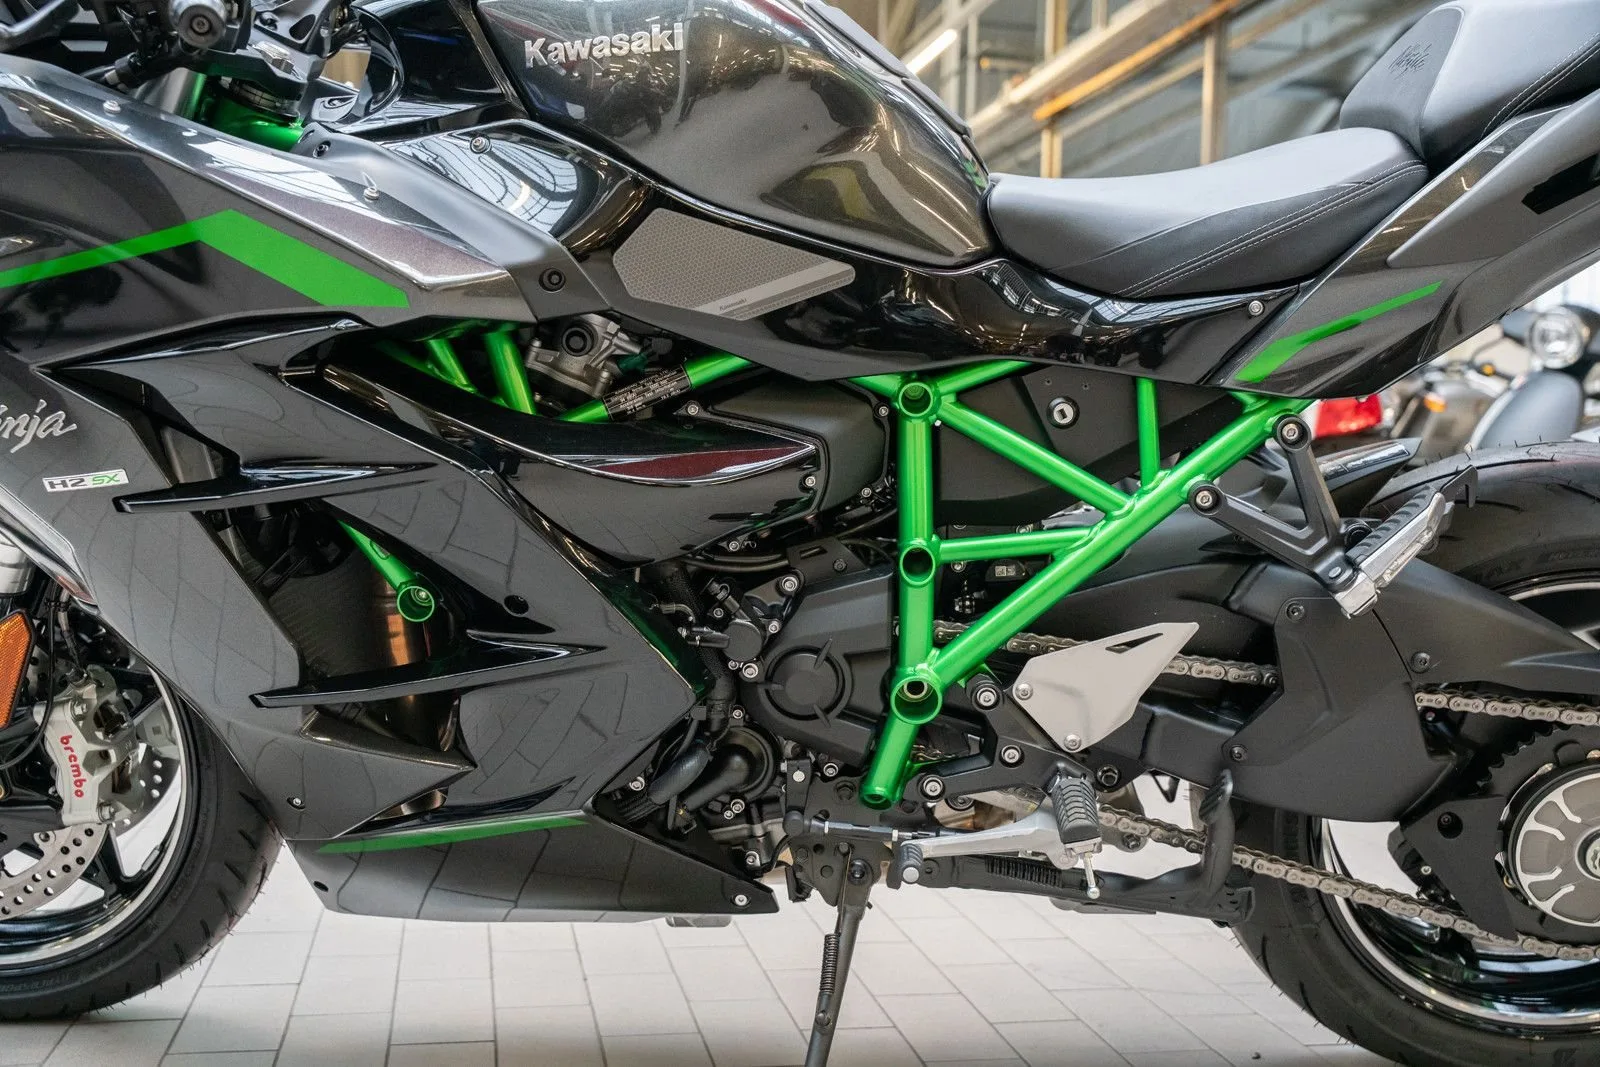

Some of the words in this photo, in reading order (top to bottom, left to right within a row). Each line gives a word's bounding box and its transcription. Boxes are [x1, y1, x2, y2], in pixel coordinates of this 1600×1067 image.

[524, 22, 685, 68] Kawasaki
[0, 399, 77, 453] nja
[48, 478, 88, 489] H2
[92, 473, 120, 485] SX
[60, 735, 87, 798] brembo
